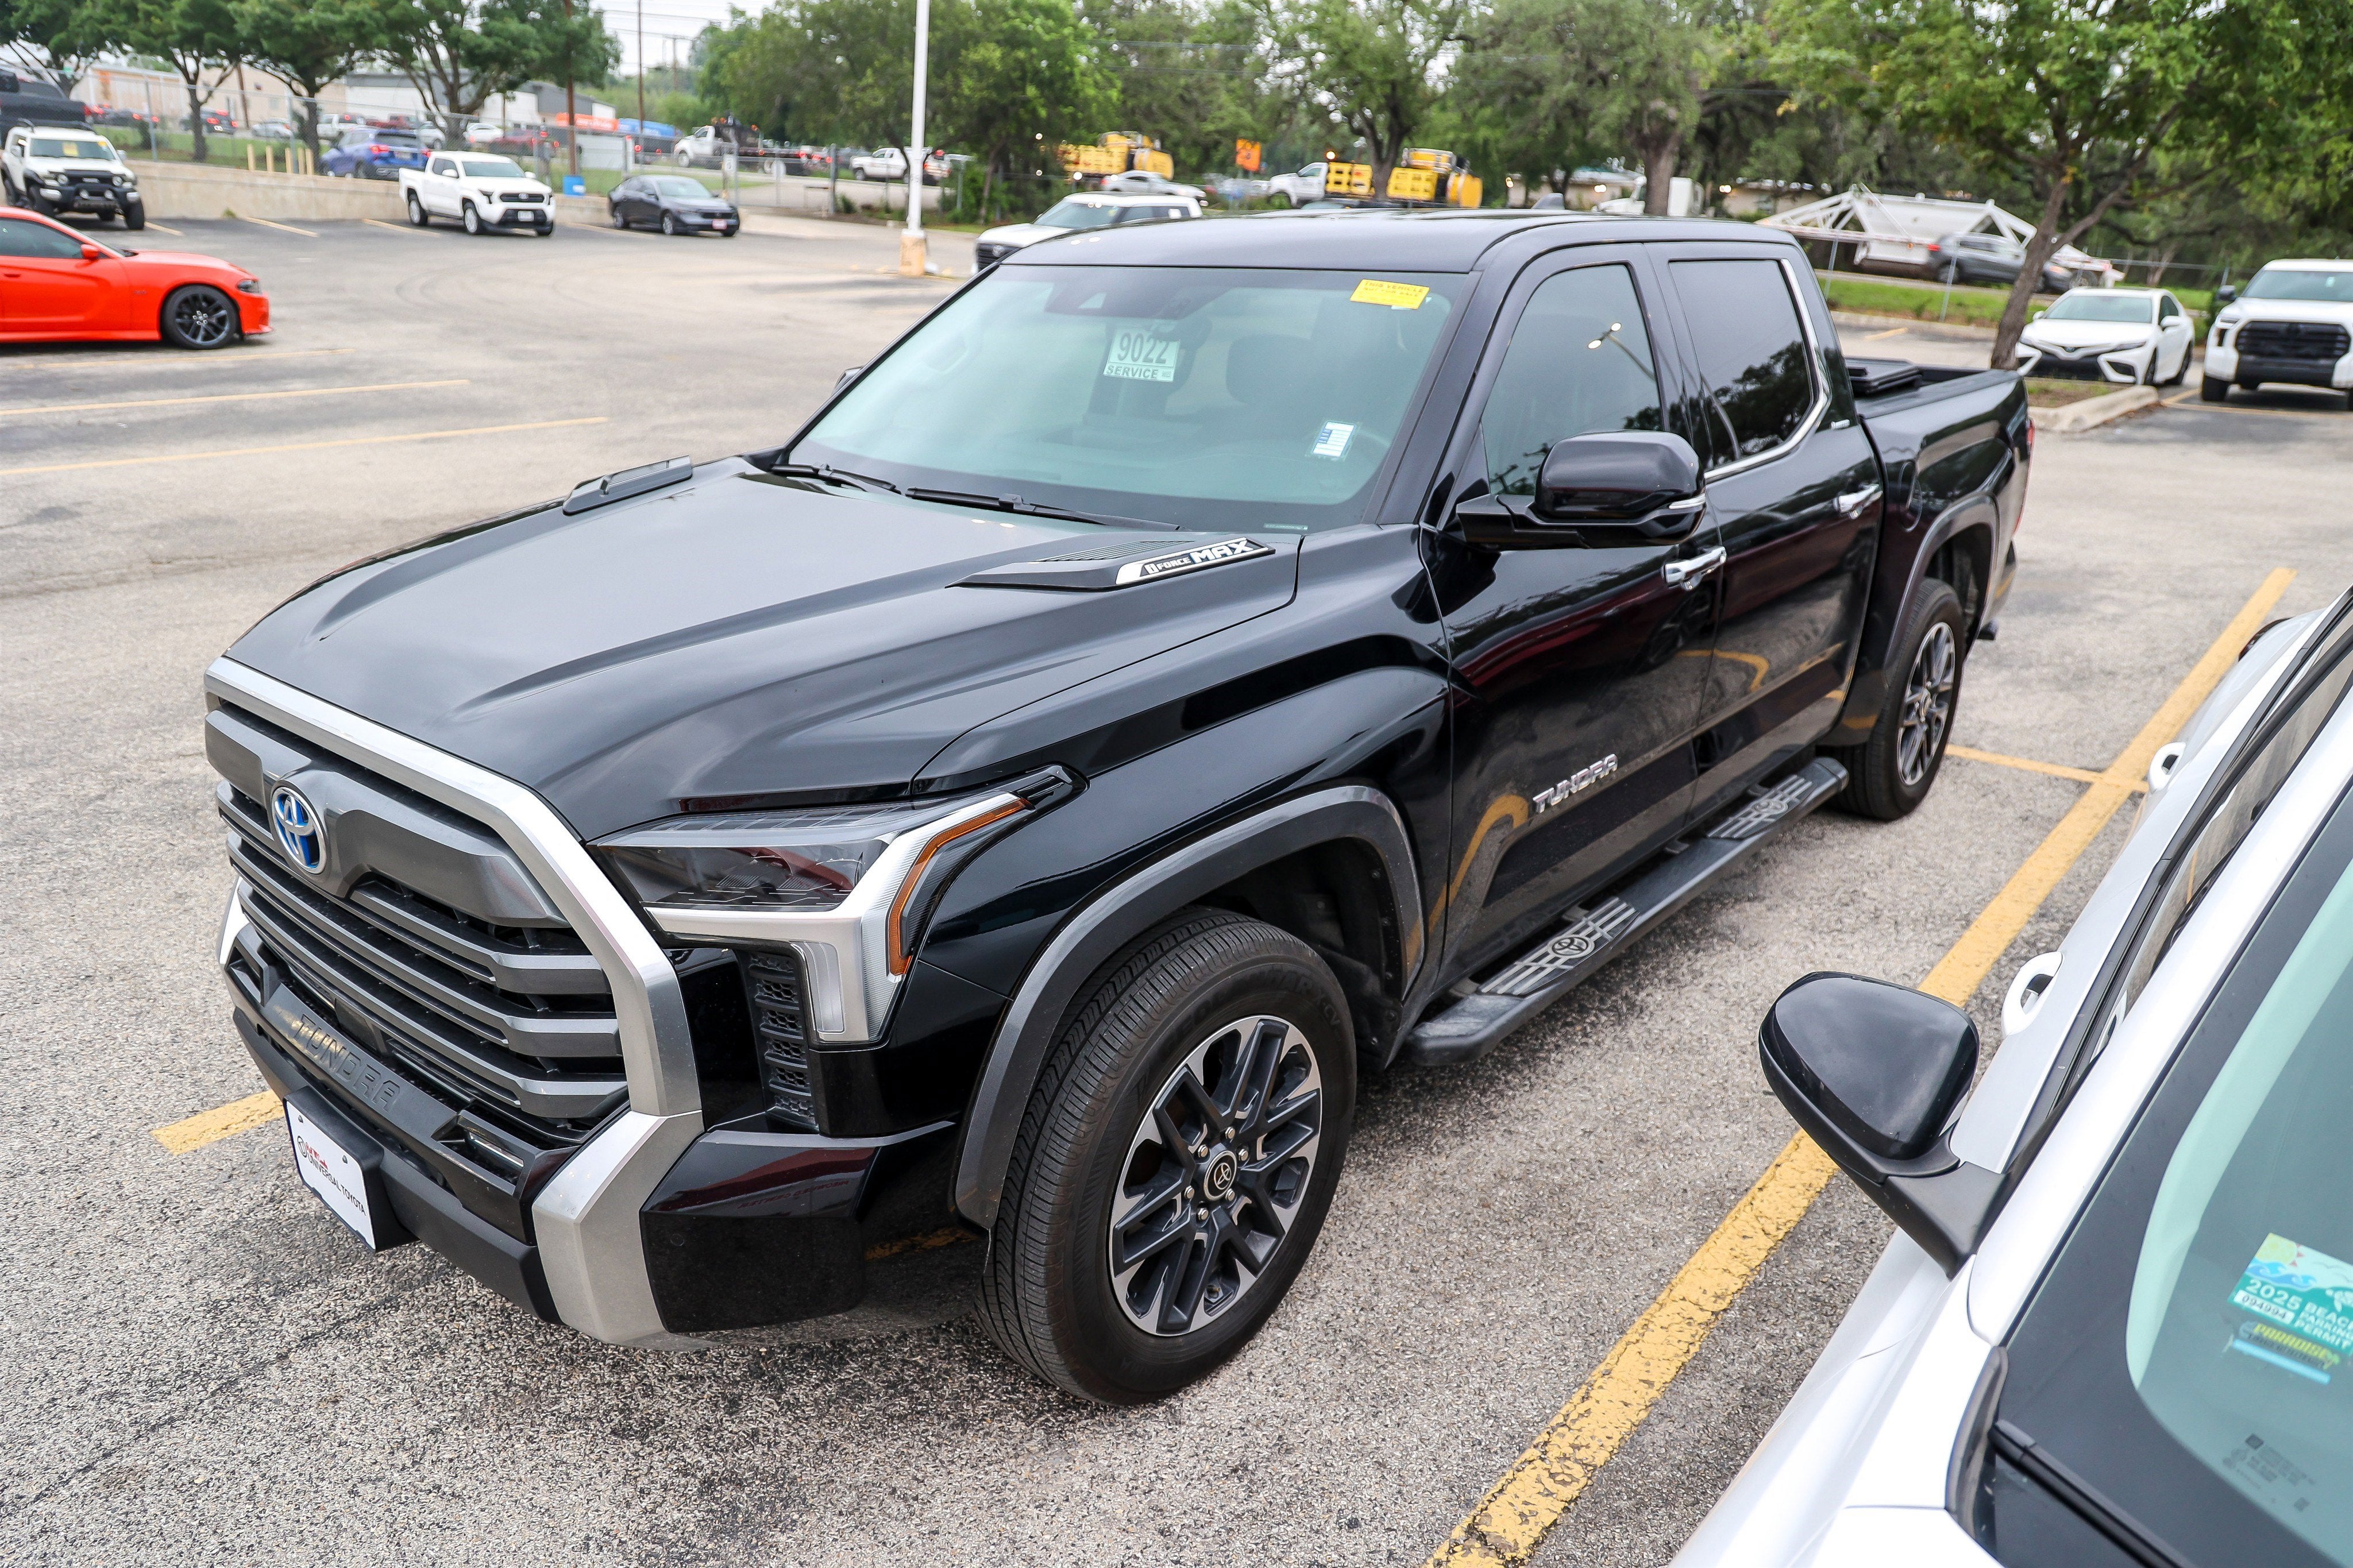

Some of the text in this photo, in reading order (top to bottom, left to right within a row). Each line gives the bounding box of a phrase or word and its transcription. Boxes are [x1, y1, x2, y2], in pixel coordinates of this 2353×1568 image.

[1387, 285, 1424, 293] VEHICLE
[1117, 332, 1170, 364] 9022
[1106, 365, 1159, 379] SERVICE
[1189, 540, 1254, 564] MAX
[1532, 753, 1618, 813] TUNDRA
[294, 1014, 400, 1112] TUNDRA
[307, 1154, 367, 1216] UNIVERSAL TOYOTA
[2242, 1295, 2287, 1320] 094994
[2247, 1279, 2302, 1310] 2025
[2293, 1319, 2352, 1350] PERMIT
